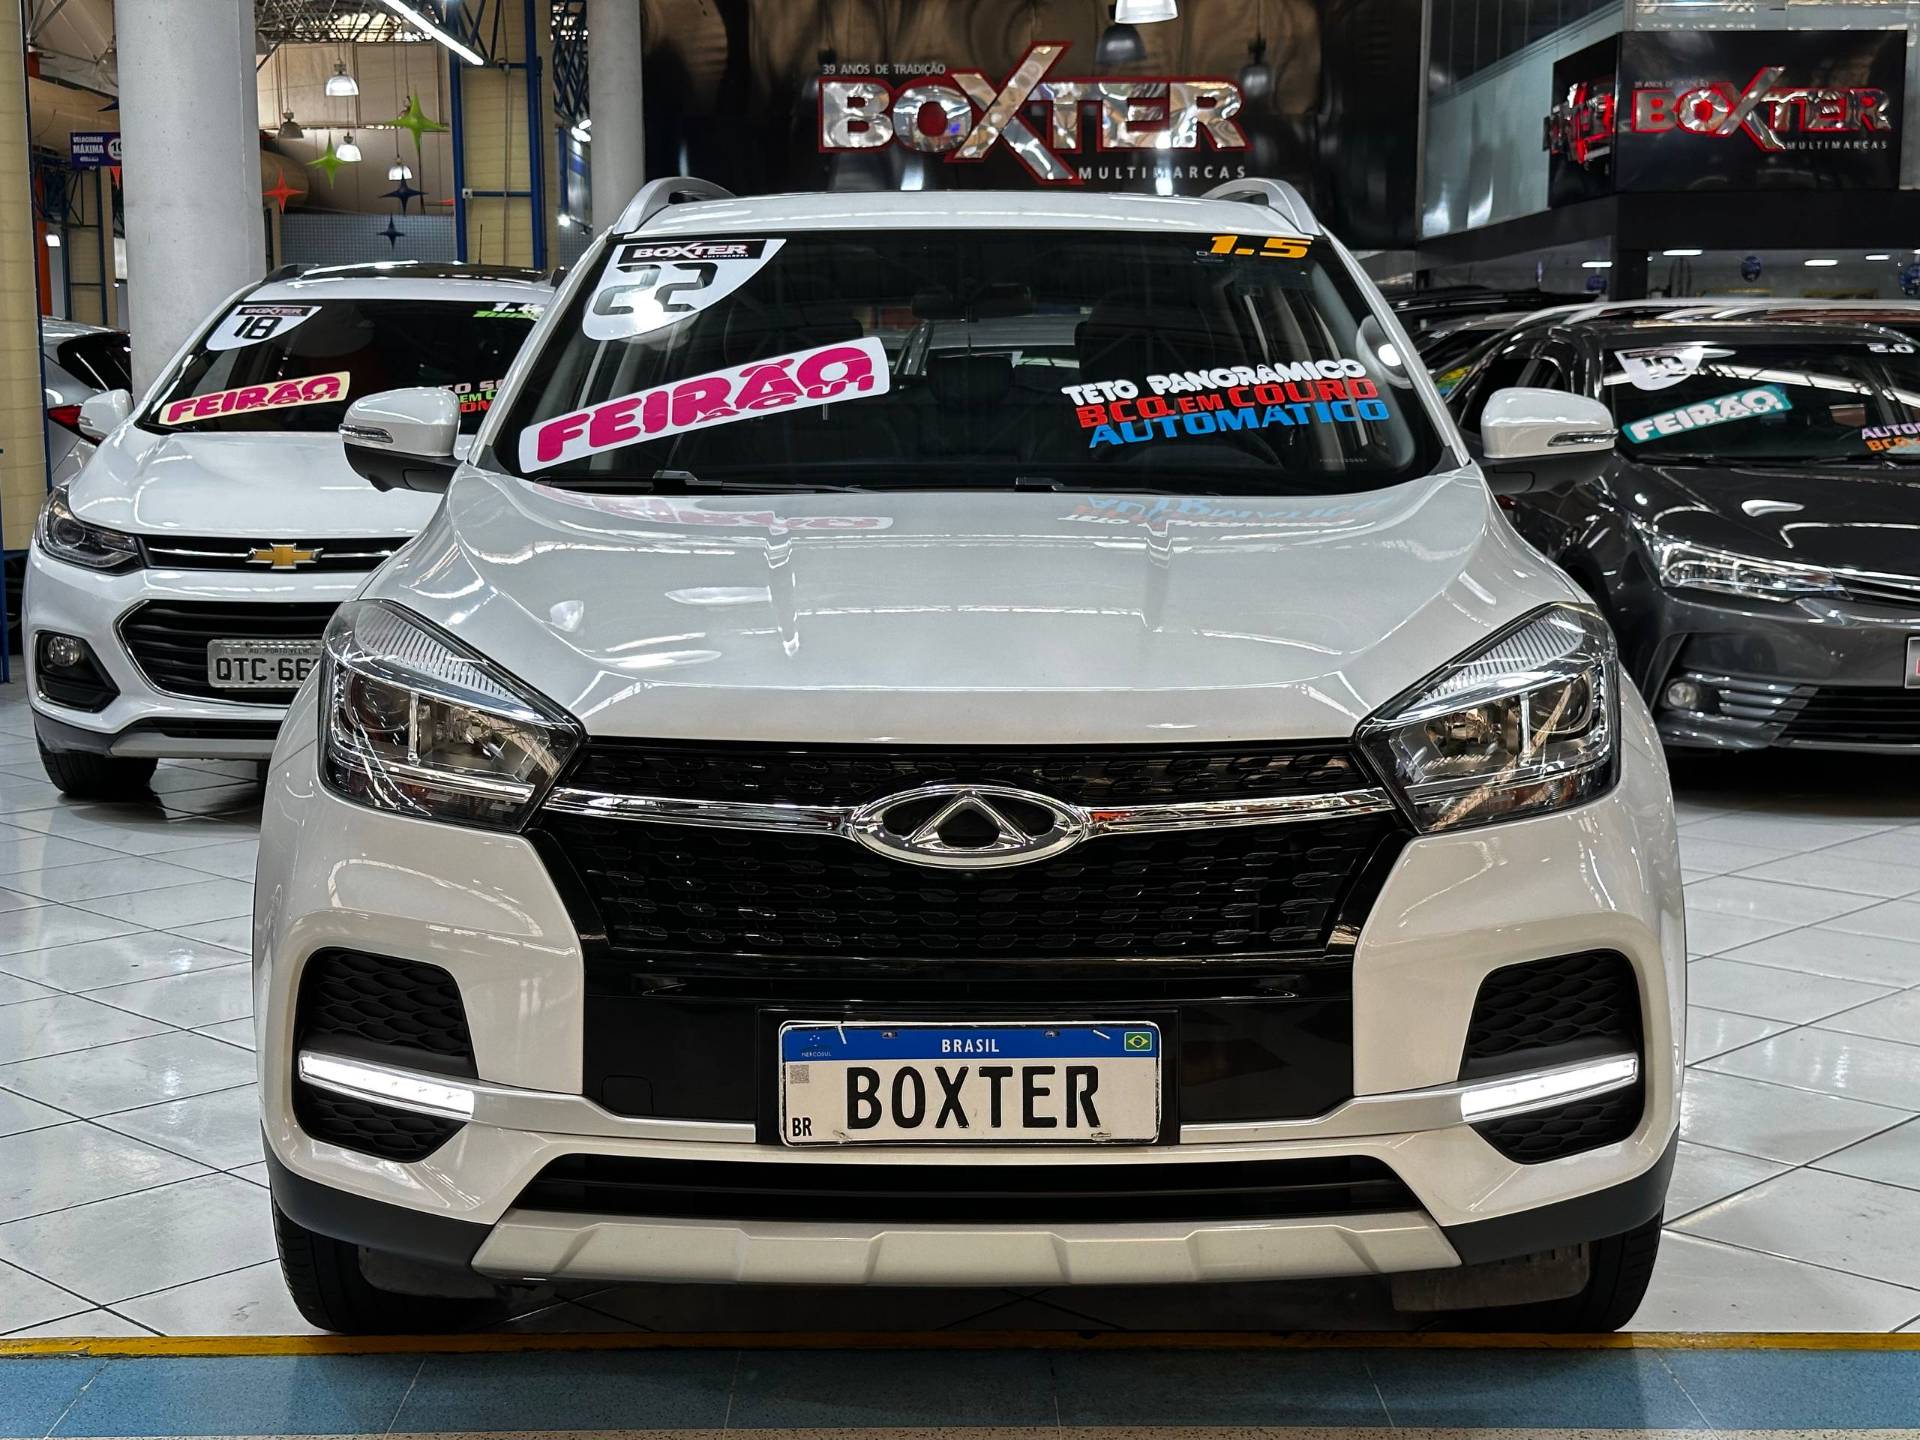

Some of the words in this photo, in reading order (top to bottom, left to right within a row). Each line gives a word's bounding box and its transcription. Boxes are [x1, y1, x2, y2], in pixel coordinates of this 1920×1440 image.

[822, 64, 836, 75] 39
[840, 64, 871, 75] ANOS
[875, 64, 889, 75] DE
[894, 61, 946, 77] TRADIÇÃO
[819, 41, 1251, 184] BOXTER
[1632, 65, 1892, 152] BOXTER
[73, 144, 104, 154] MÁXIMA
[1787, 141, 1888, 150] MULTIMARCAS
[1078, 166, 1246, 180] MULTIMARCAS
[633, 243, 749, 259] BOXTER
[1210, 235, 1312, 259] 1.5
[593, 262, 718, 316] 22
[233, 316, 283, 340] 18
[1062, 379, 1138, 406] TETO
[1146, 358, 1367, 396] PANORÂMICO
[1179, 393, 1223, 414] EM
[1228, 378, 1379, 409] COURO
[167, 376, 341, 422] FEIRÃO
[537, 347, 874, 462] FEIRÃO
[1630, 390, 1778, 441] FEIRÃO
[942, 1039, 1000, 1053] BRASIL
[847, 1066, 1101, 1130] BOXTER
[792, 1117, 812, 1137] BR
